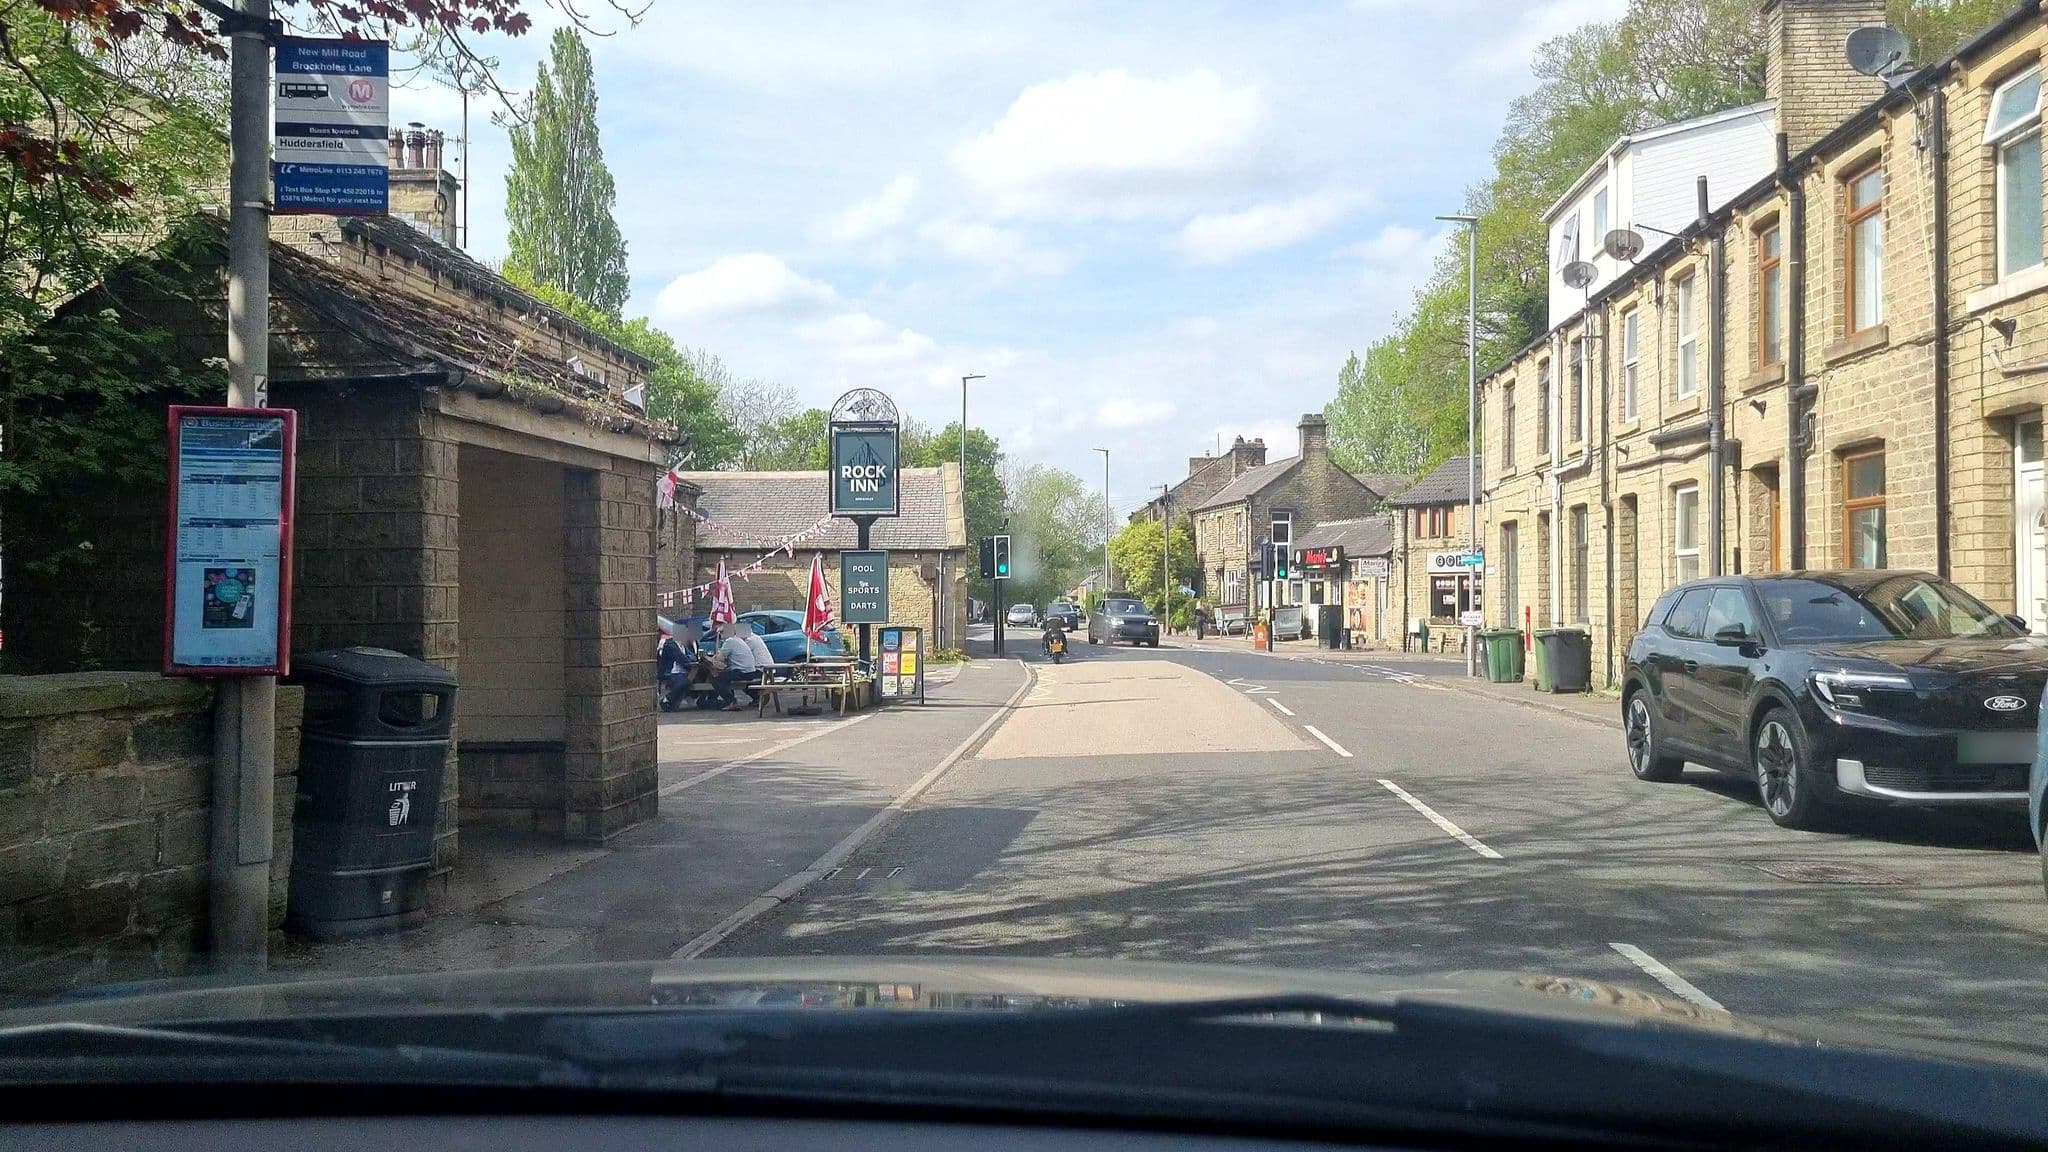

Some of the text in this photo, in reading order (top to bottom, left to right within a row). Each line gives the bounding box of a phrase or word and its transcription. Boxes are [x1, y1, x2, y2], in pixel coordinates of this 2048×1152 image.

[298, 47, 367, 58] New Mill Road
[292, 61, 372, 73] Brockholes Lane
[331, 128, 359, 136] towards
[280, 138, 344, 149] Huddersfield
[841, 465, 887, 479] ROCK
[850, 479, 879, 492] INN
[852, 565, 875, 573] POOL
[847, 586, 880, 594] SPORTS
[850, 602, 877, 610] DARTS
[1992, 698, 2018, 708] Ford
